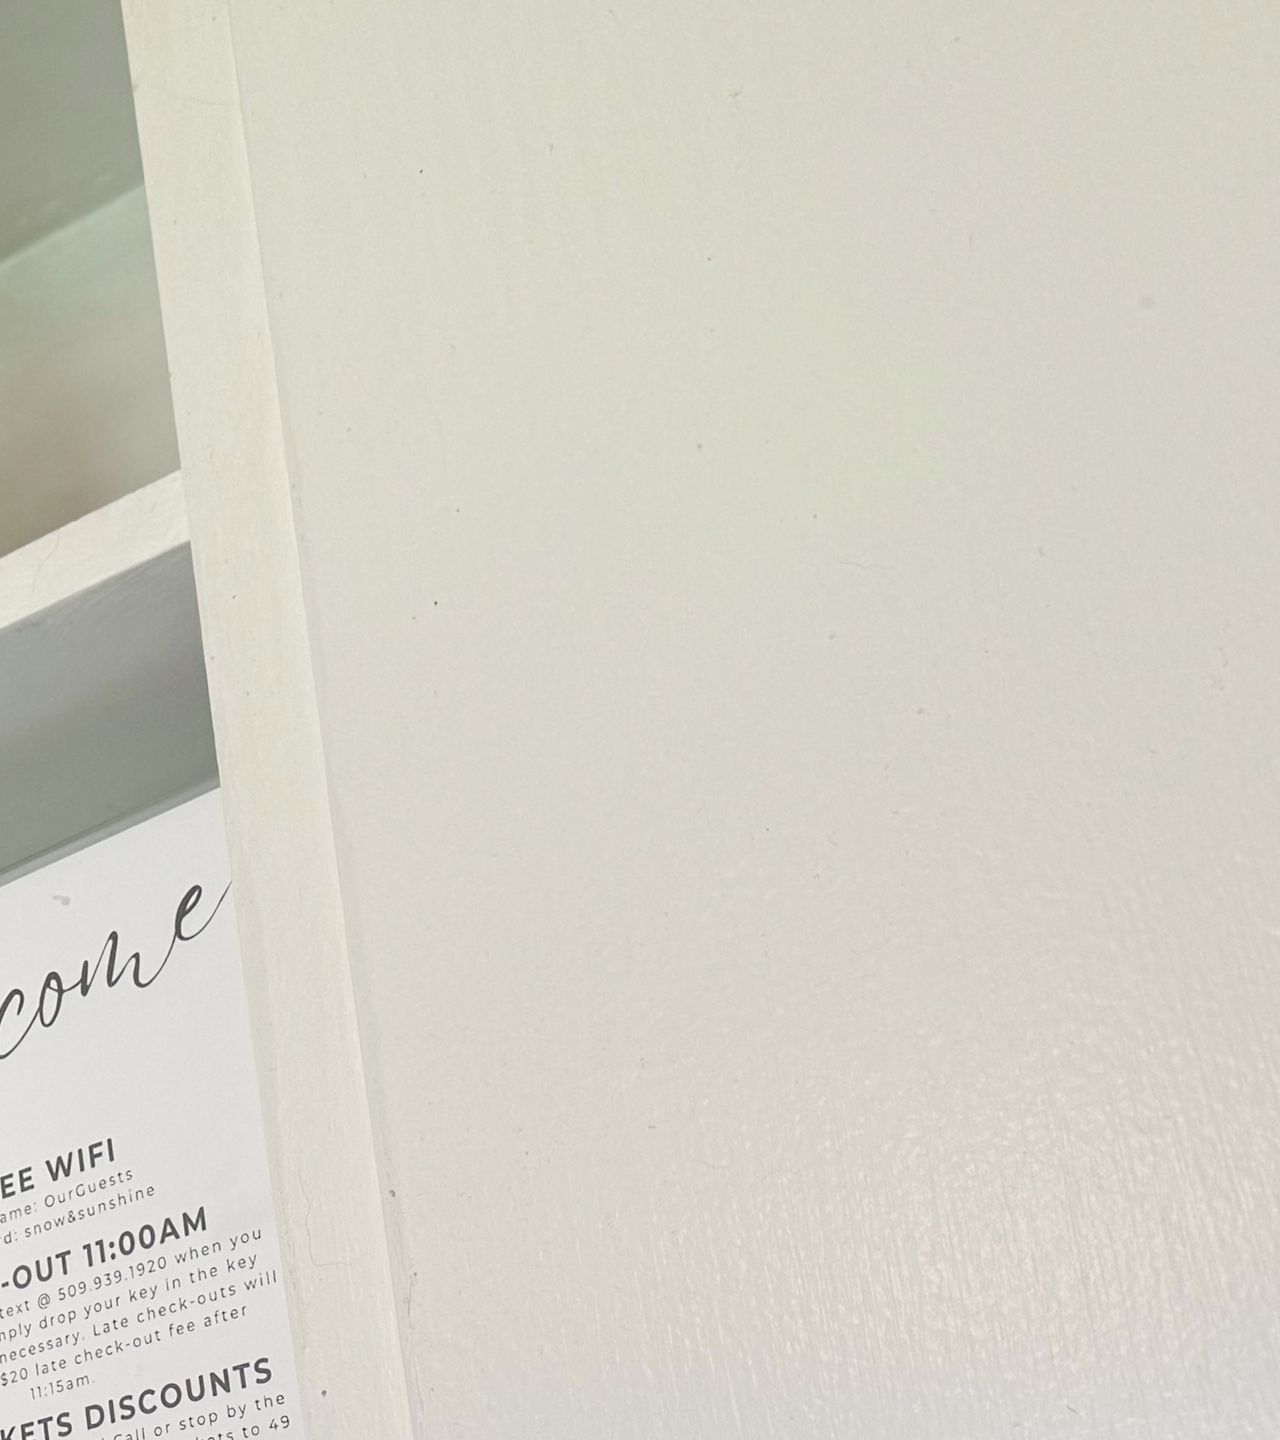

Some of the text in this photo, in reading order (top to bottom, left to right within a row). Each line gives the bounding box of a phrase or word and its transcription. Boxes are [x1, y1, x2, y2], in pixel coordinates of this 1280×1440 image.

[42, 1169, 133, 1209] OurGuests
[43, 1137, 115, 1183] WIFI
[23, 1185, 155, 1239] snow&sunshine
[80, 1205, 207, 1268] 11:00AM
[36, 1292, 51, 1310] @
[56, 1255, 167, 1302] 509.939.1920
[173, 1241, 222, 1265] when
[228, 1229, 262, 1252] you
[37, 1309, 77, 1330] drop
[82, 1295, 121, 1321] your
[127, 1284, 158, 1303] key
[164, 1277, 182, 1292] in
[187, 1266, 218, 1284] the
[225, 1254, 257, 1273] key
[91, 1317, 129, 1337] Late
[135, 1284, 237, 1324] check-outs
[242, 1269, 277, 1291] will
[0, 1367, 29, 1388] $20
[34, 1358, 67, 1377] late
[73, 1330, 161, 1366] check-out
[167, 1320, 196, 1337] fee
[202, 1305, 247, 1328] after
[29, 1374, 95, 1400] 11:15am.
[83, 1356, 273, 1431] DISCOUNTS
[152, 1423, 171, 1438] or
[177, 1411, 218, 1431] stop
[225, 1403, 247, 1420] by
[253, 1394, 285, 1412] the
[240, 1424, 260, 1439] to
[267, 1414, 290, 1431] 49
